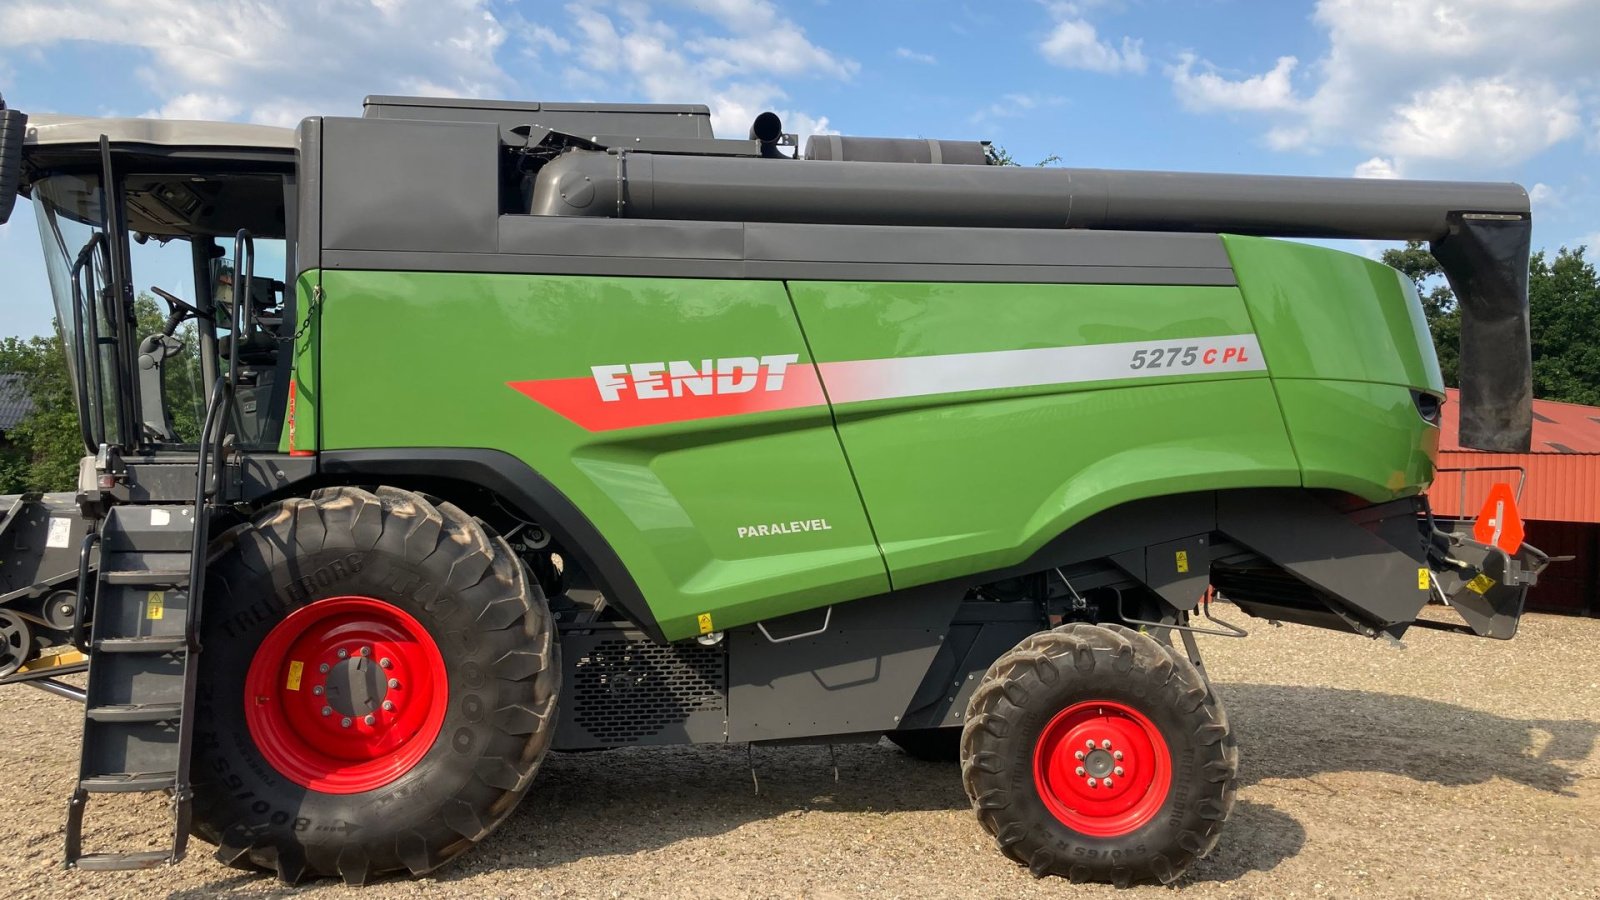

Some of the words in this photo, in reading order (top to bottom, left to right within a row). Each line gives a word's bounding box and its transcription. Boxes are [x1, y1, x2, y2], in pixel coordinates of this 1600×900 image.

[1130, 346, 1198, 370] 5275
[1202, 348, 1218, 365] C
[1222, 346, 1249, 364] PL
[590, 353, 799, 402] FENDT
[737, 518, 832, 539] PARALEVEL
